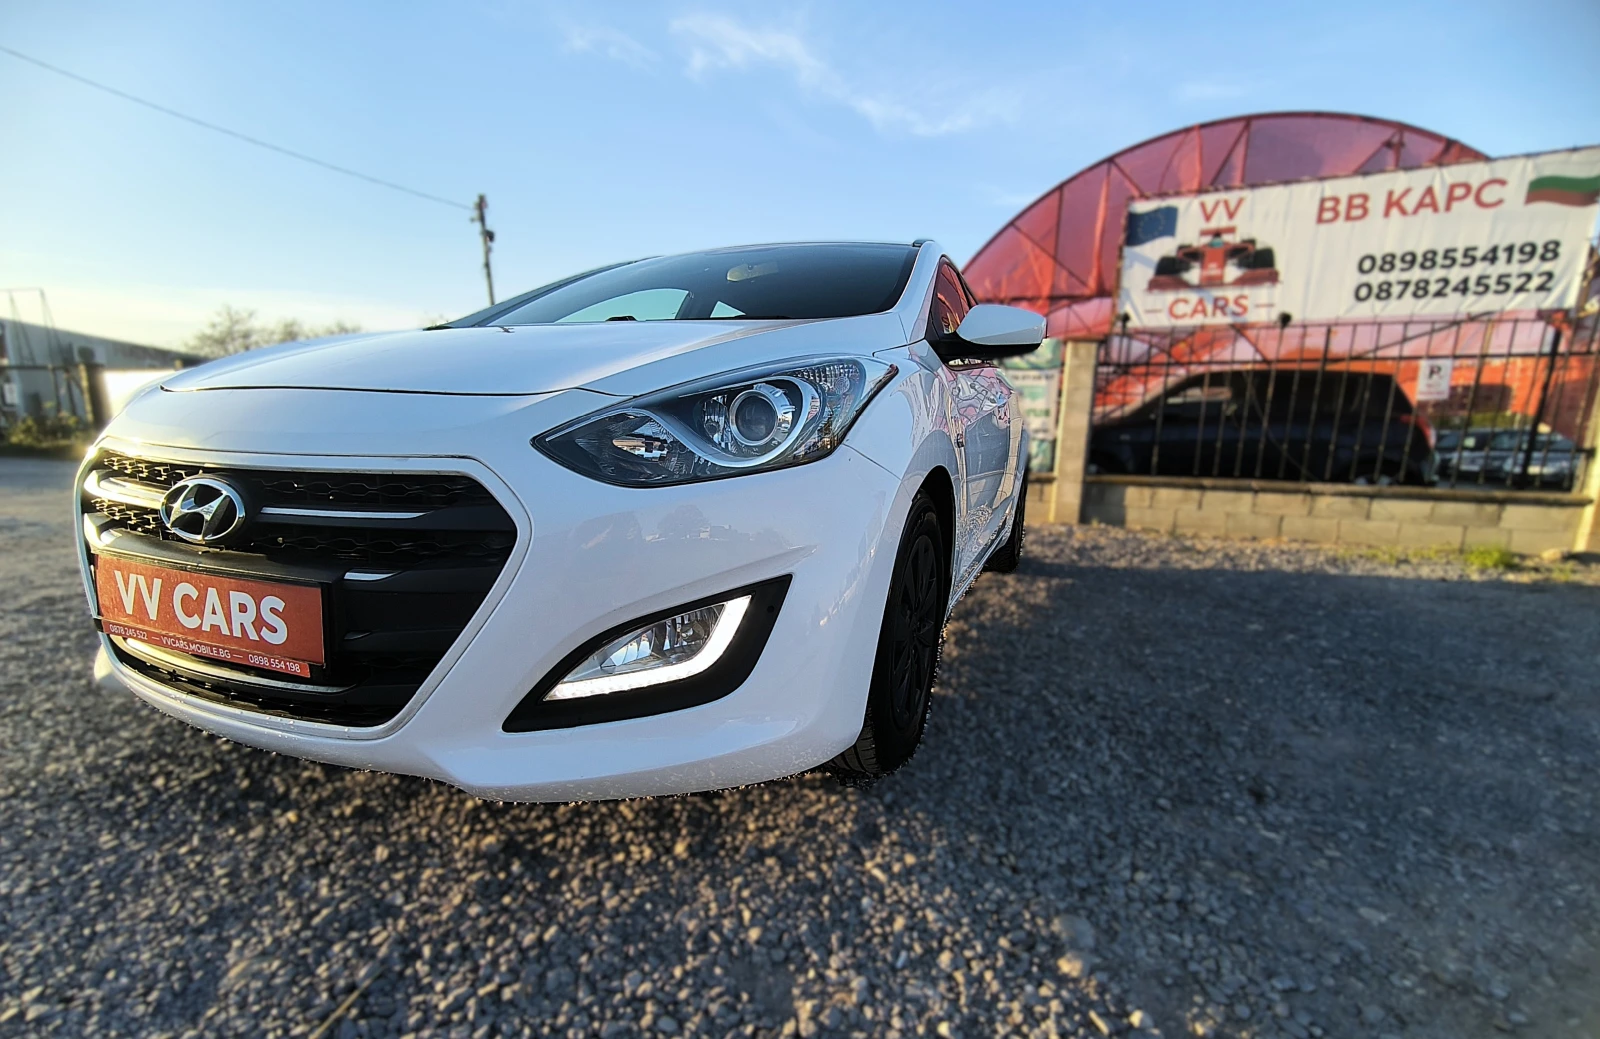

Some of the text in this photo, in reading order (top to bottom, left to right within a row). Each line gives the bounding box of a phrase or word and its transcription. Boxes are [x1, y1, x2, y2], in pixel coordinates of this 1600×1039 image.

[1200, 198, 1244, 222] VV
[1383, 178, 1508, 218] КАРС
[1357, 239, 1561, 275] 0898554198
[1354, 271, 1555, 302] 0878245522
[1168, 294, 1249, 320] CARS
[114, 570, 288, 645] VV CARS
[109, 624, 301, 673] 0878 245 522 VVCARS.MOBILE.BG 0898 554 198
